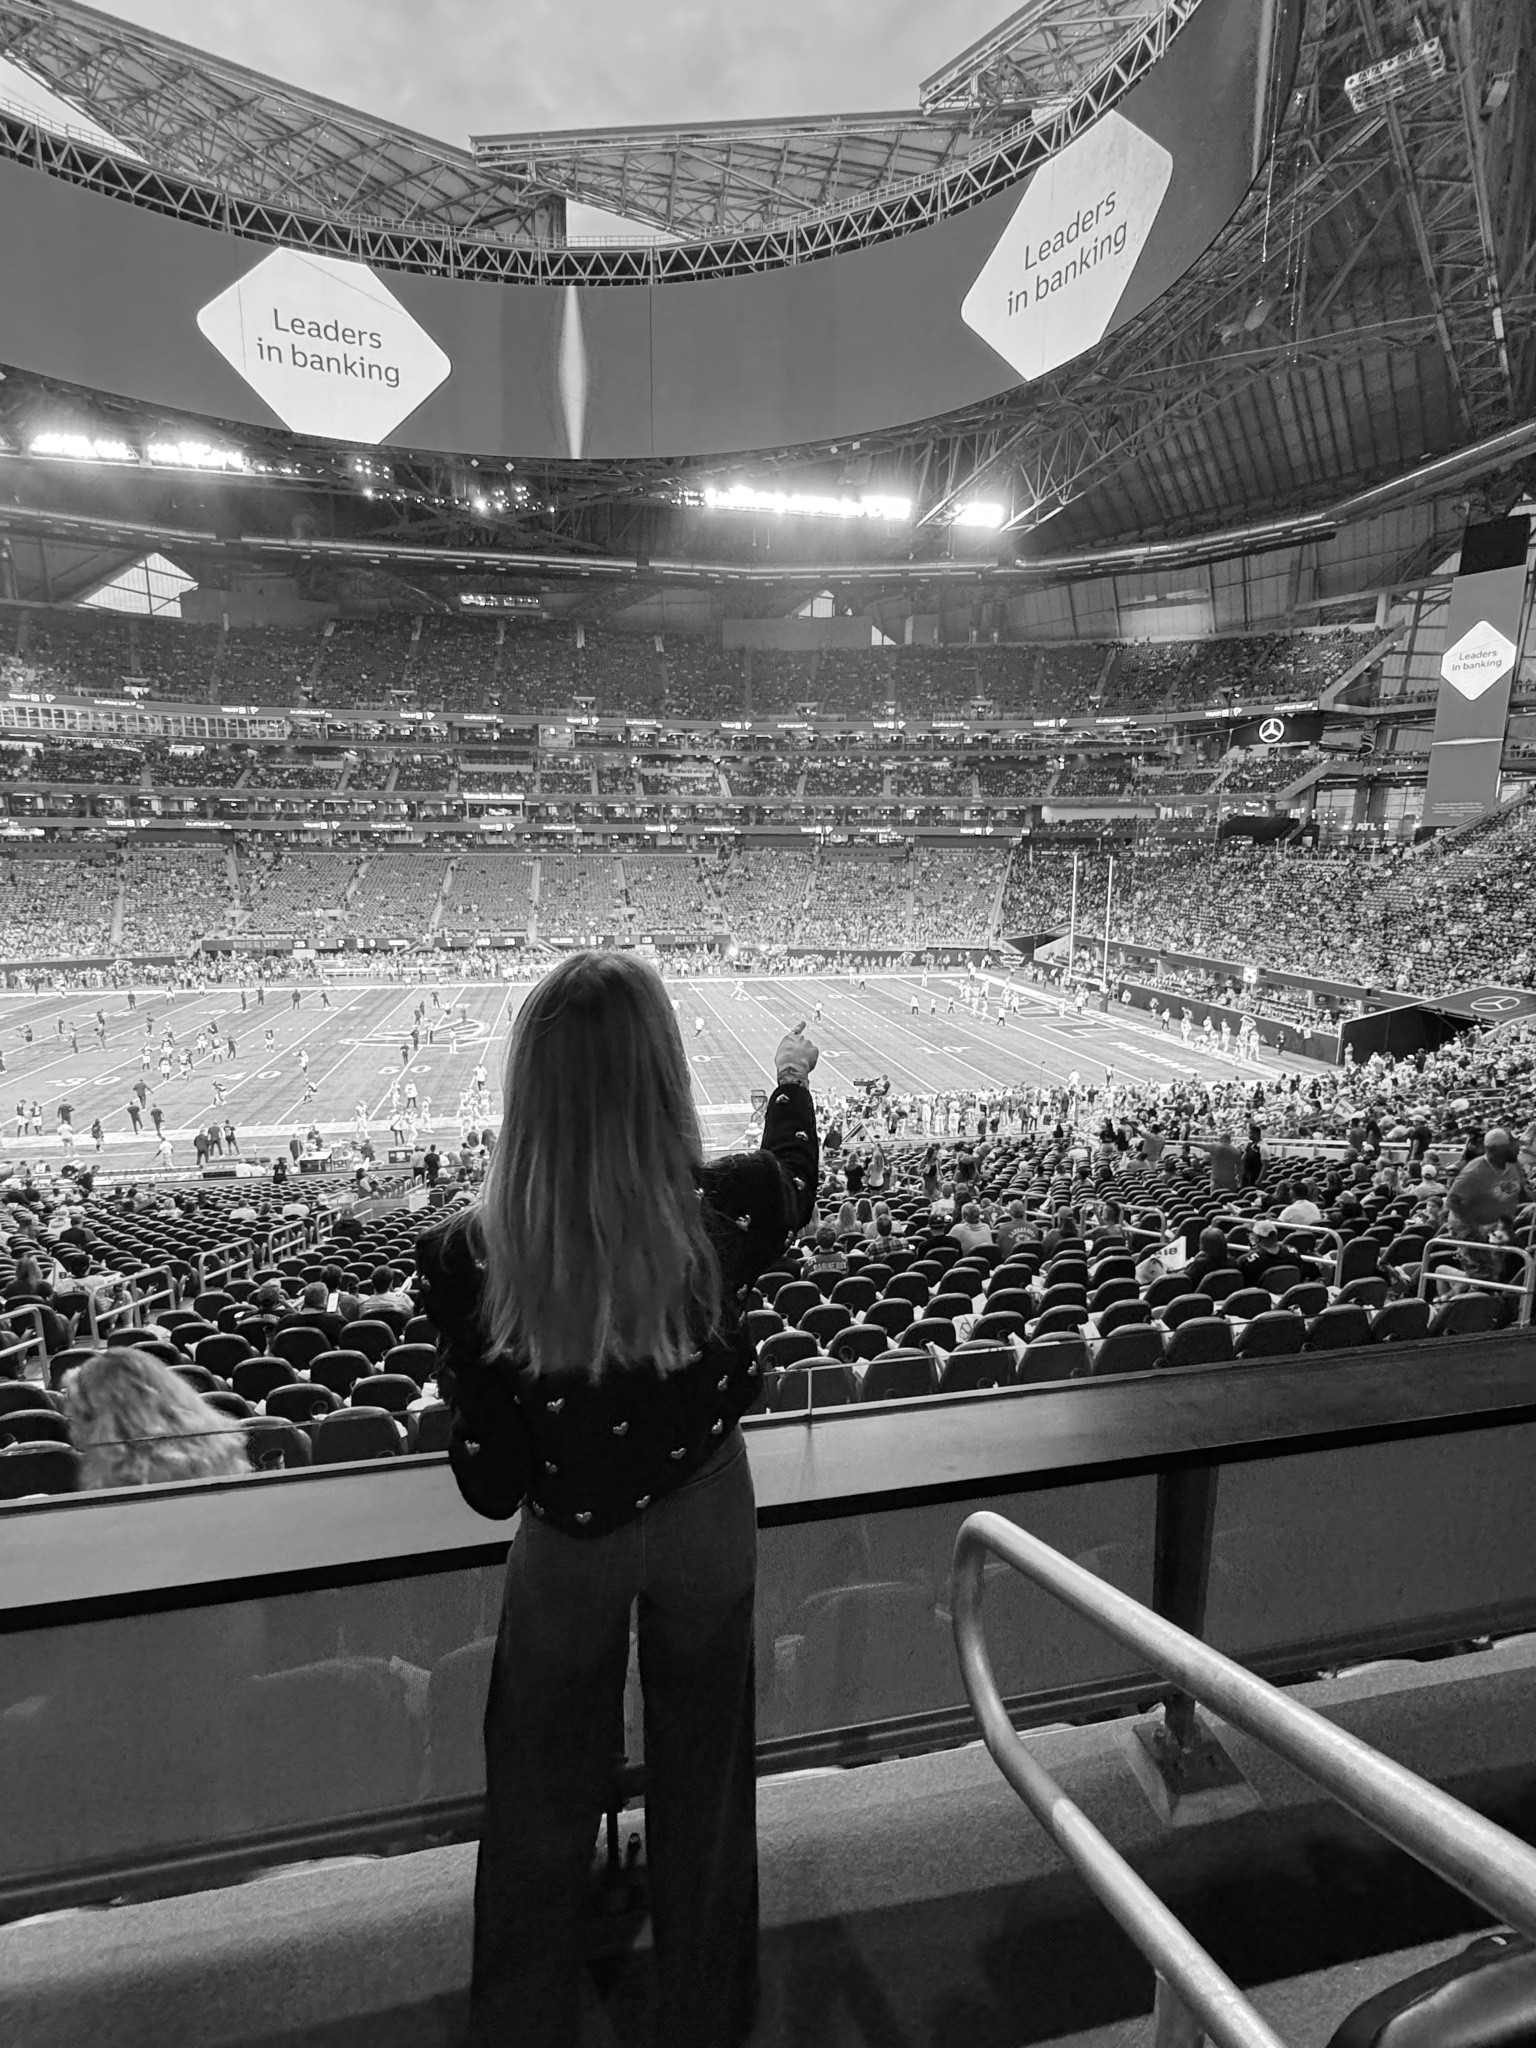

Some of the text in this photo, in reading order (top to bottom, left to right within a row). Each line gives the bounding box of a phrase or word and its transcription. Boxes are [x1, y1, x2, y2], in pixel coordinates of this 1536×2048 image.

[1024, 191, 1116, 271] Leaders
[1007, 221, 1127, 316] in banking
[273, 308, 382, 349] Leaders
[256, 337, 400, 388] in banking
[1459, 650, 1497, 661] Leaders
[1463, 659, 1502, 670] banking
[1356, 823, 1376, 831] ATL
